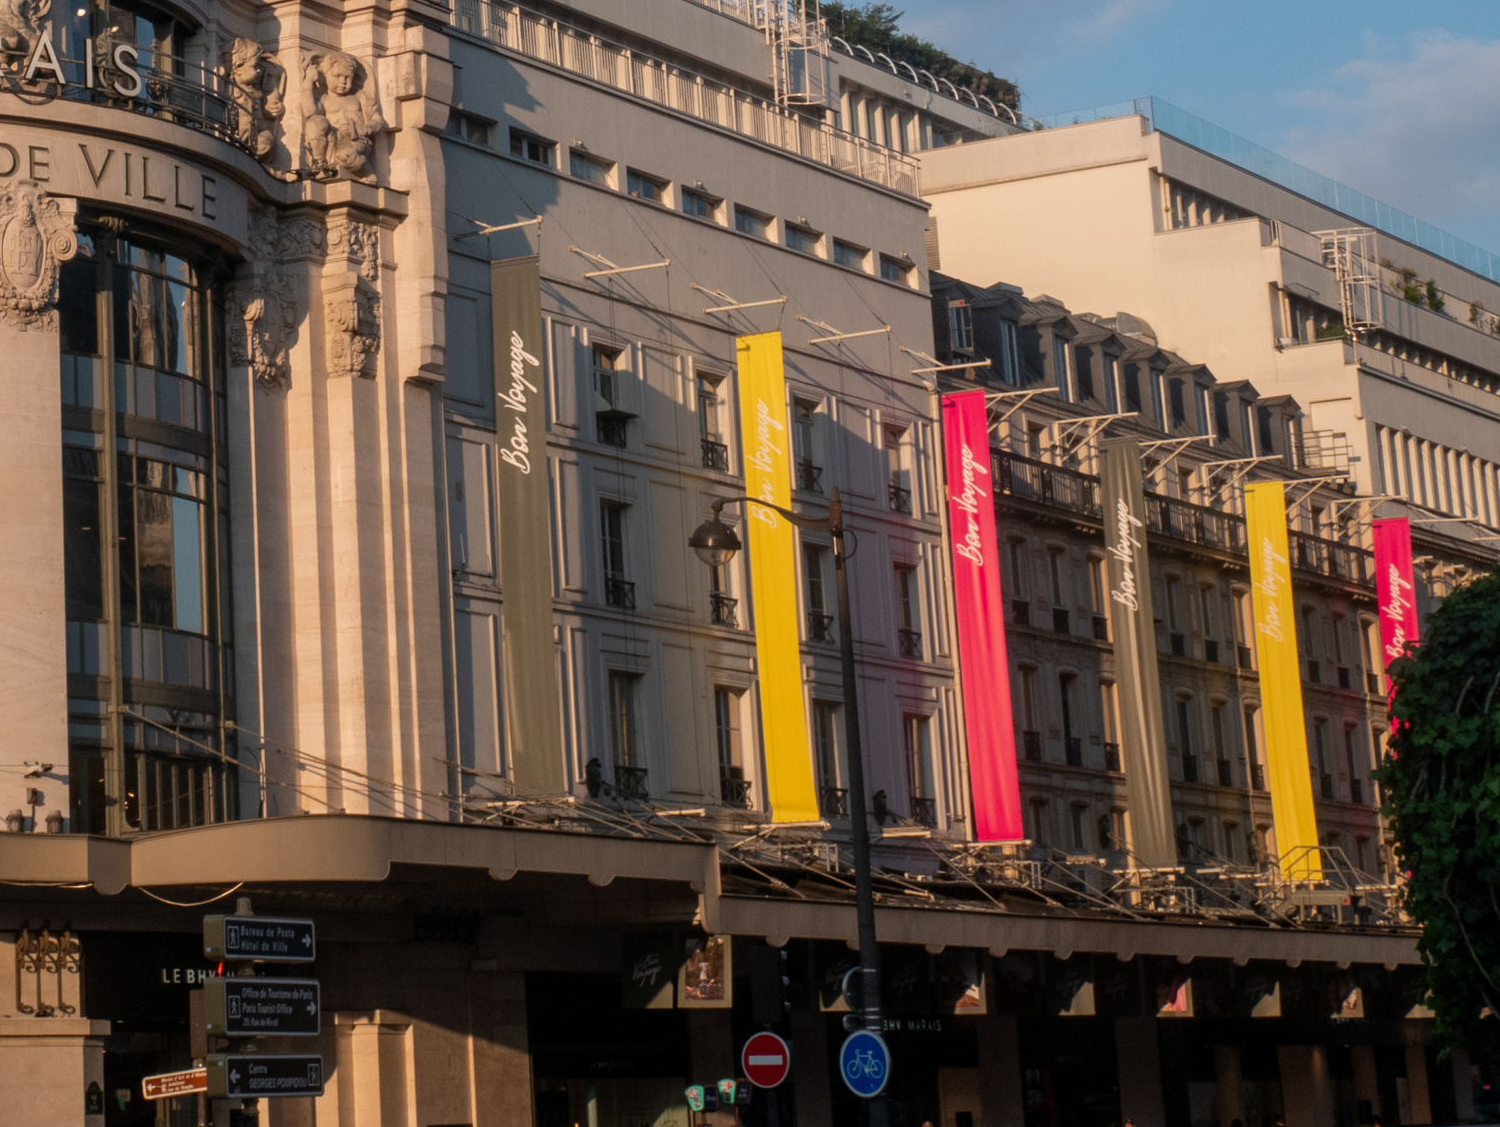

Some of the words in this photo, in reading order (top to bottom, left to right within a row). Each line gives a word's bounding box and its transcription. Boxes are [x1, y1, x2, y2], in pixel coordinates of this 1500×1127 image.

[78, 143, 216, 220] VILLE
[497, 330, 540, 412] Voyage
[500, 417, 531, 474] Bon
[746, 398, 784, 472] Voyage
[952, 443, 987, 513] Voyage
[956, 517, 983, 566] Bon
[1107, 498, 1142, 563] Voyage
[1111, 565, 1138, 611] Bon
[1254, 537, 1287, 597] Voyage
[1381, 563, 1412, 621] Voyage
[1258, 600, 1283, 642] Bon
[241, 925, 264, 937] Bureau
[266, 926, 274, 937] de
[277, 926, 295, 938] Poste
[261, 941, 269, 951] de
[273, 941, 288, 952] Ville
[162, 968, 181, 984] LE
[242, 987, 259, 998] Office
[260, 988, 267, 999] de
[268, 988, 291, 999] Tourisme
[292, 989, 298, 999] de
[248, 1063, 268, 1074] Centre
[249, 1077, 276, 1089] GEORGES
[277, 1076, 307, 1088] POMPIDOU
